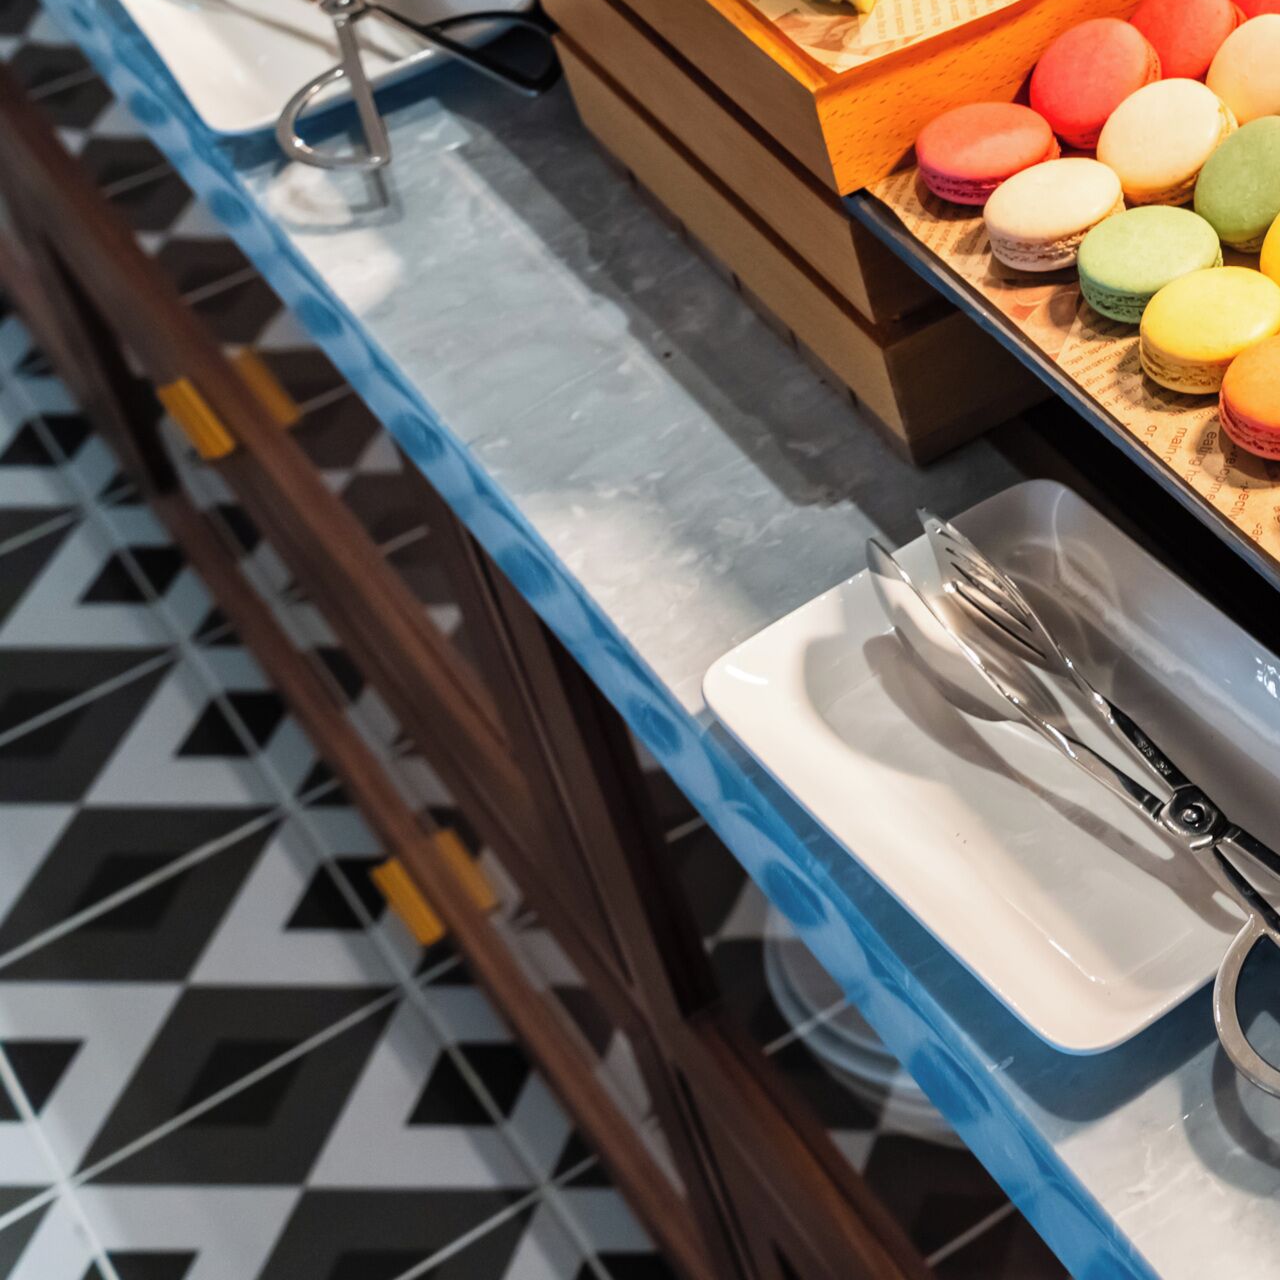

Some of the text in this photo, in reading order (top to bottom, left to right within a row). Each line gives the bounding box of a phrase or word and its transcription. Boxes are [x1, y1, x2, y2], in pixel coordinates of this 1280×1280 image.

[1143, 422, 1159, 439] or
[1164, 424, 1188, 458] main
[1187, 427, 1218, 470] eating
[1135, 738, 1156, 759] SUS
